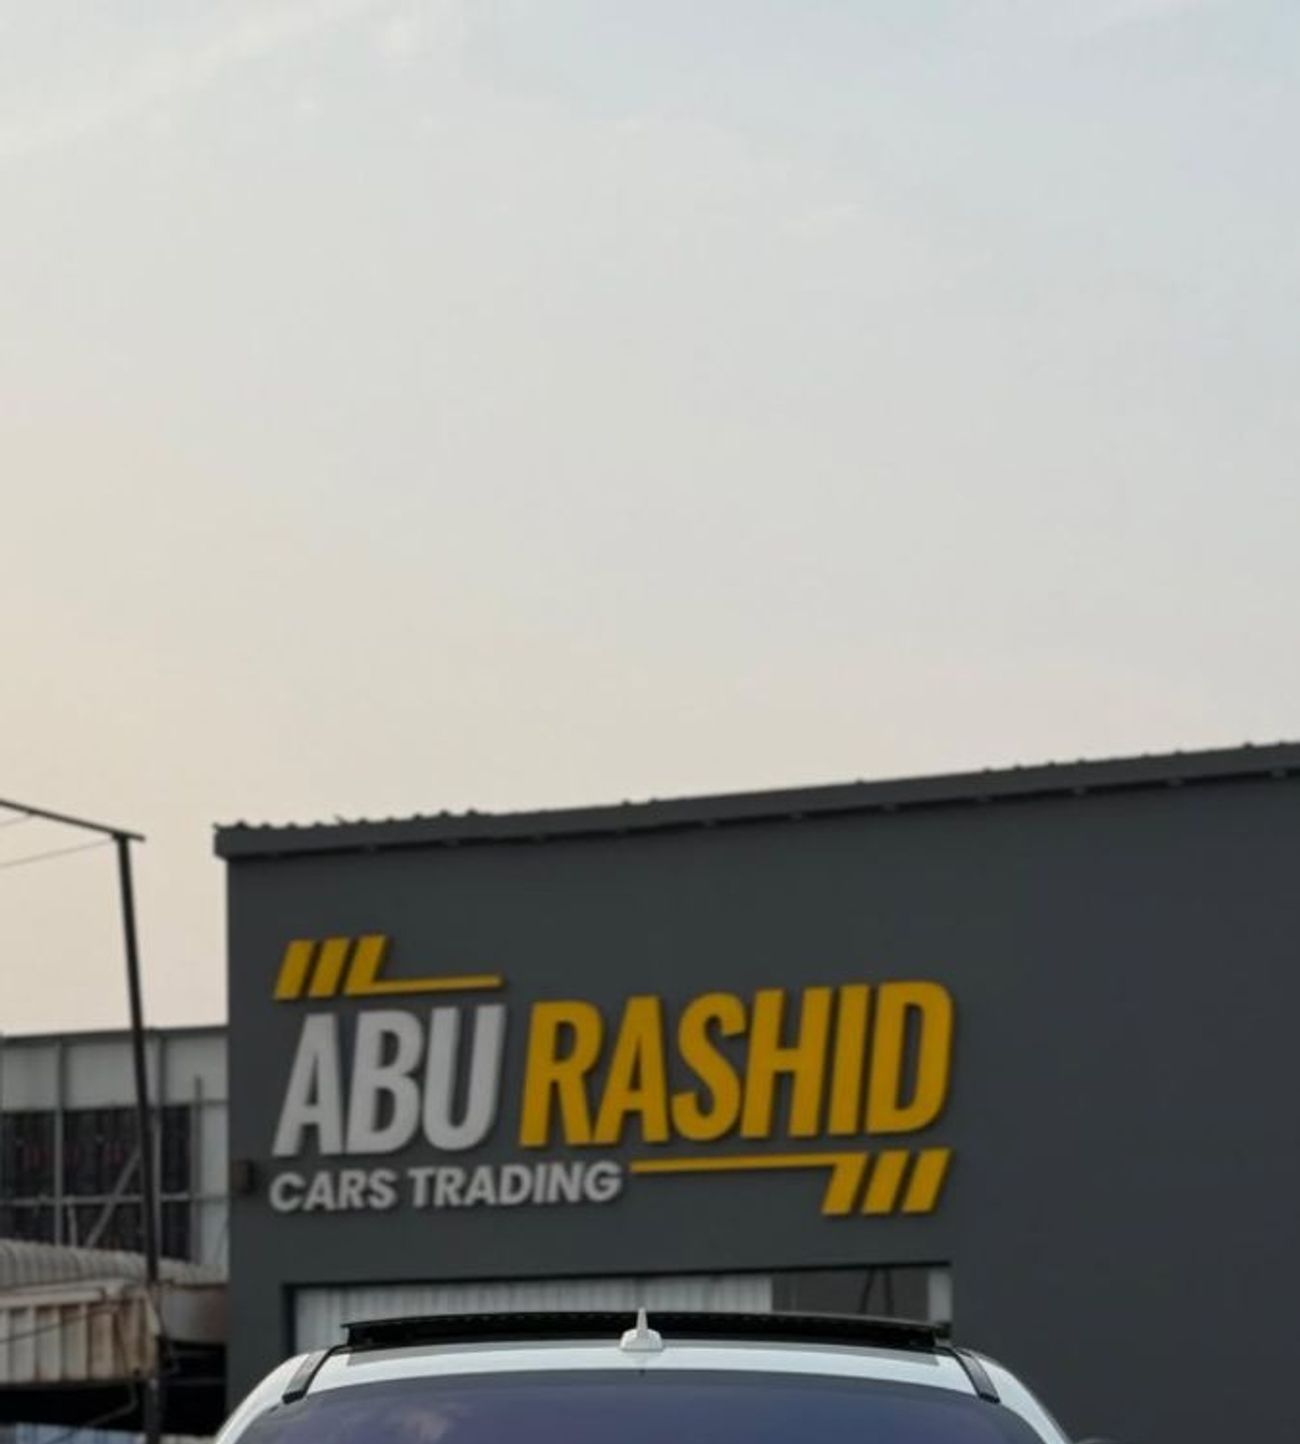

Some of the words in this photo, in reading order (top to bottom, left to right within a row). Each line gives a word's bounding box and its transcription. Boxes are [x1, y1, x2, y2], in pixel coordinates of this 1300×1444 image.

[272, 1004, 506, 1156] ABU
[519, 981, 953, 1147] RASHID
[270, 1167, 399, 1212] CARS
[408, 1161, 623, 1208] TRADING
